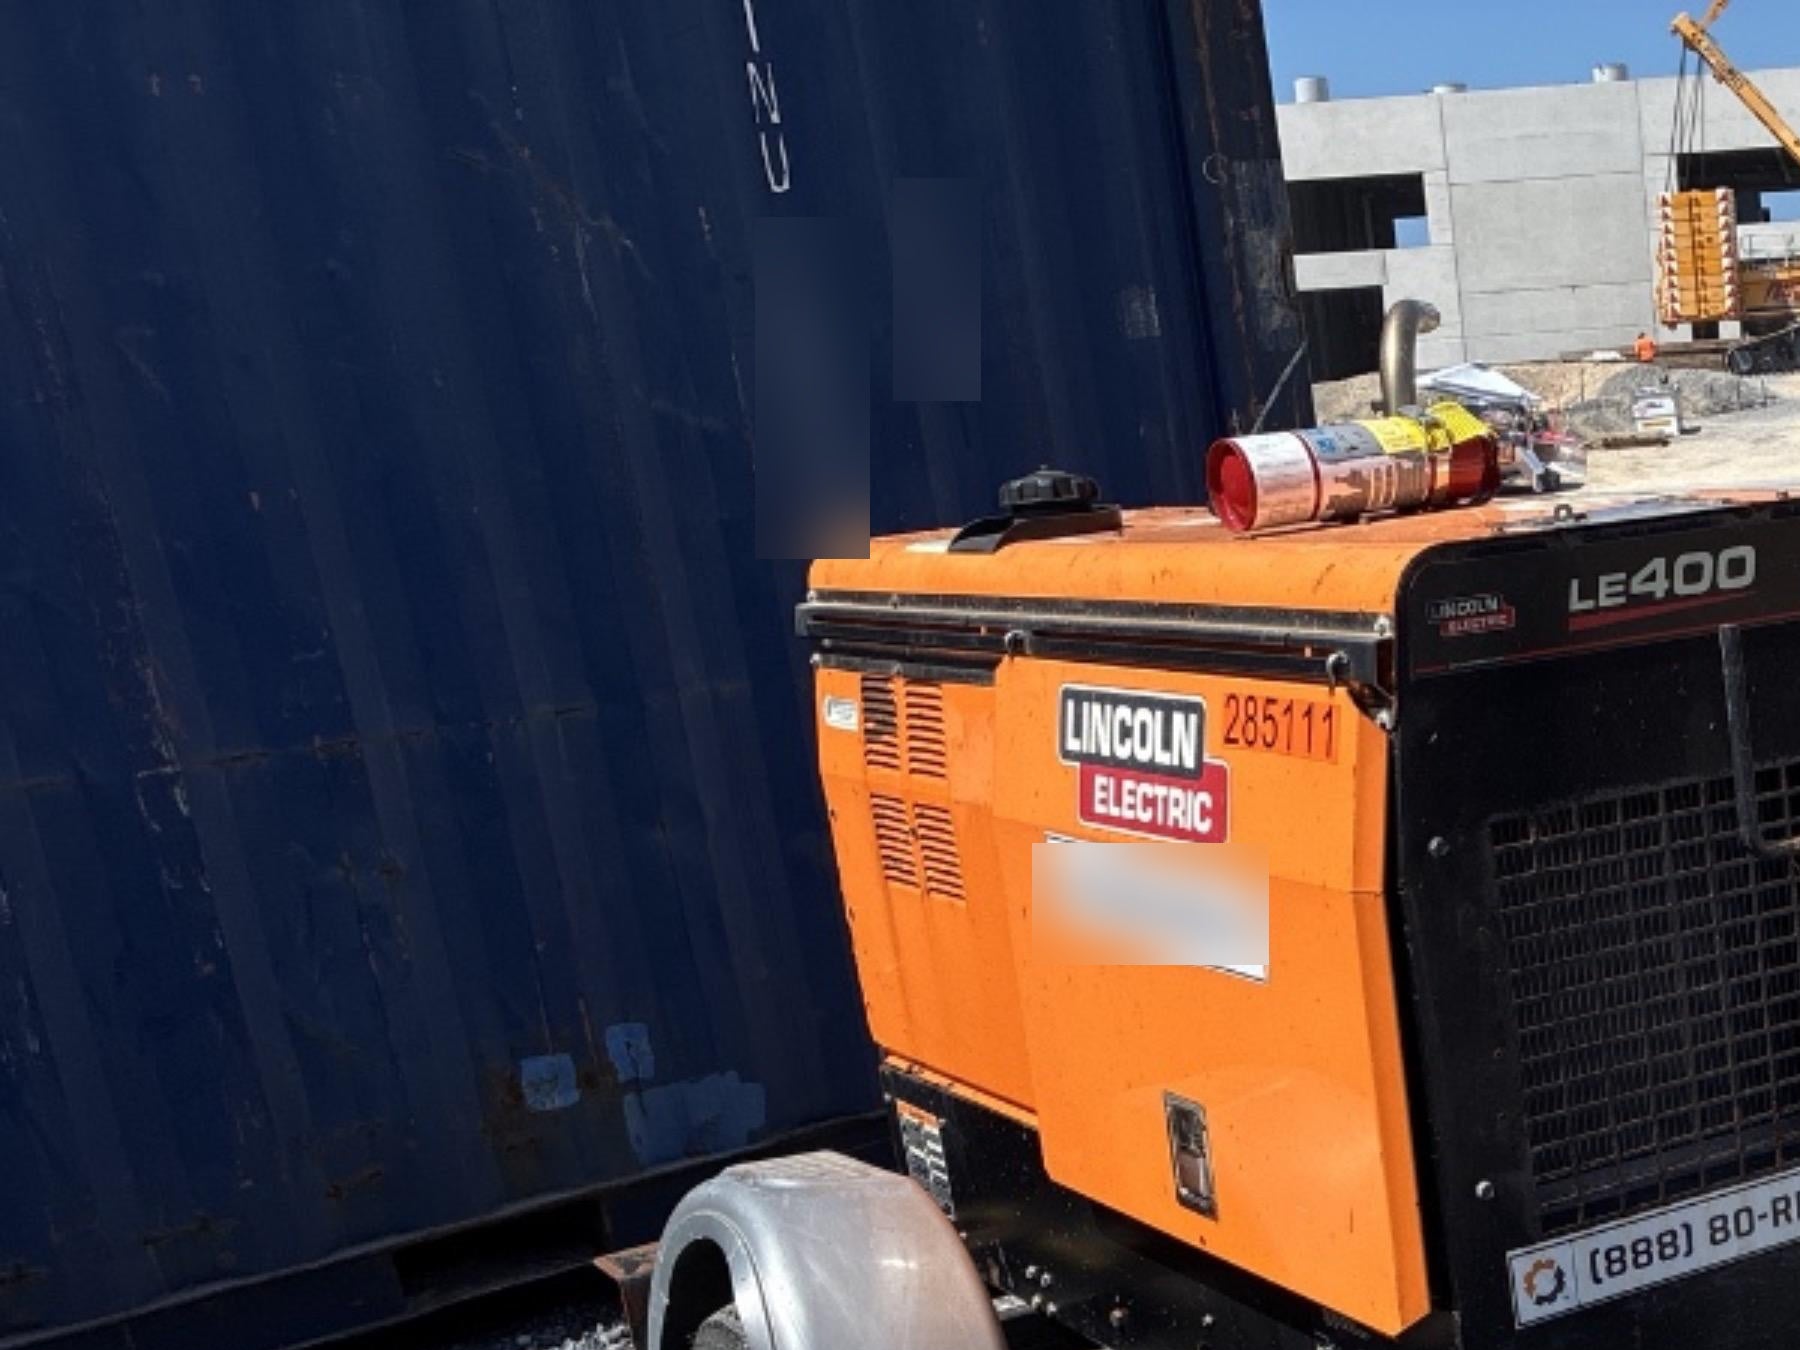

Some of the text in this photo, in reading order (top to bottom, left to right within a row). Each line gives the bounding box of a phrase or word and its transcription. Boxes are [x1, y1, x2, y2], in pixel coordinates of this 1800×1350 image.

[1429, 595, 1498, 619] LINCOLN
[1567, 544, 1757, 613] LE400
[1064, 698, 1199, 770] LINCOLN
[1223, 692, 1335, 759] 285111
[1093, 773, 1213, 834] ELECTRIC
